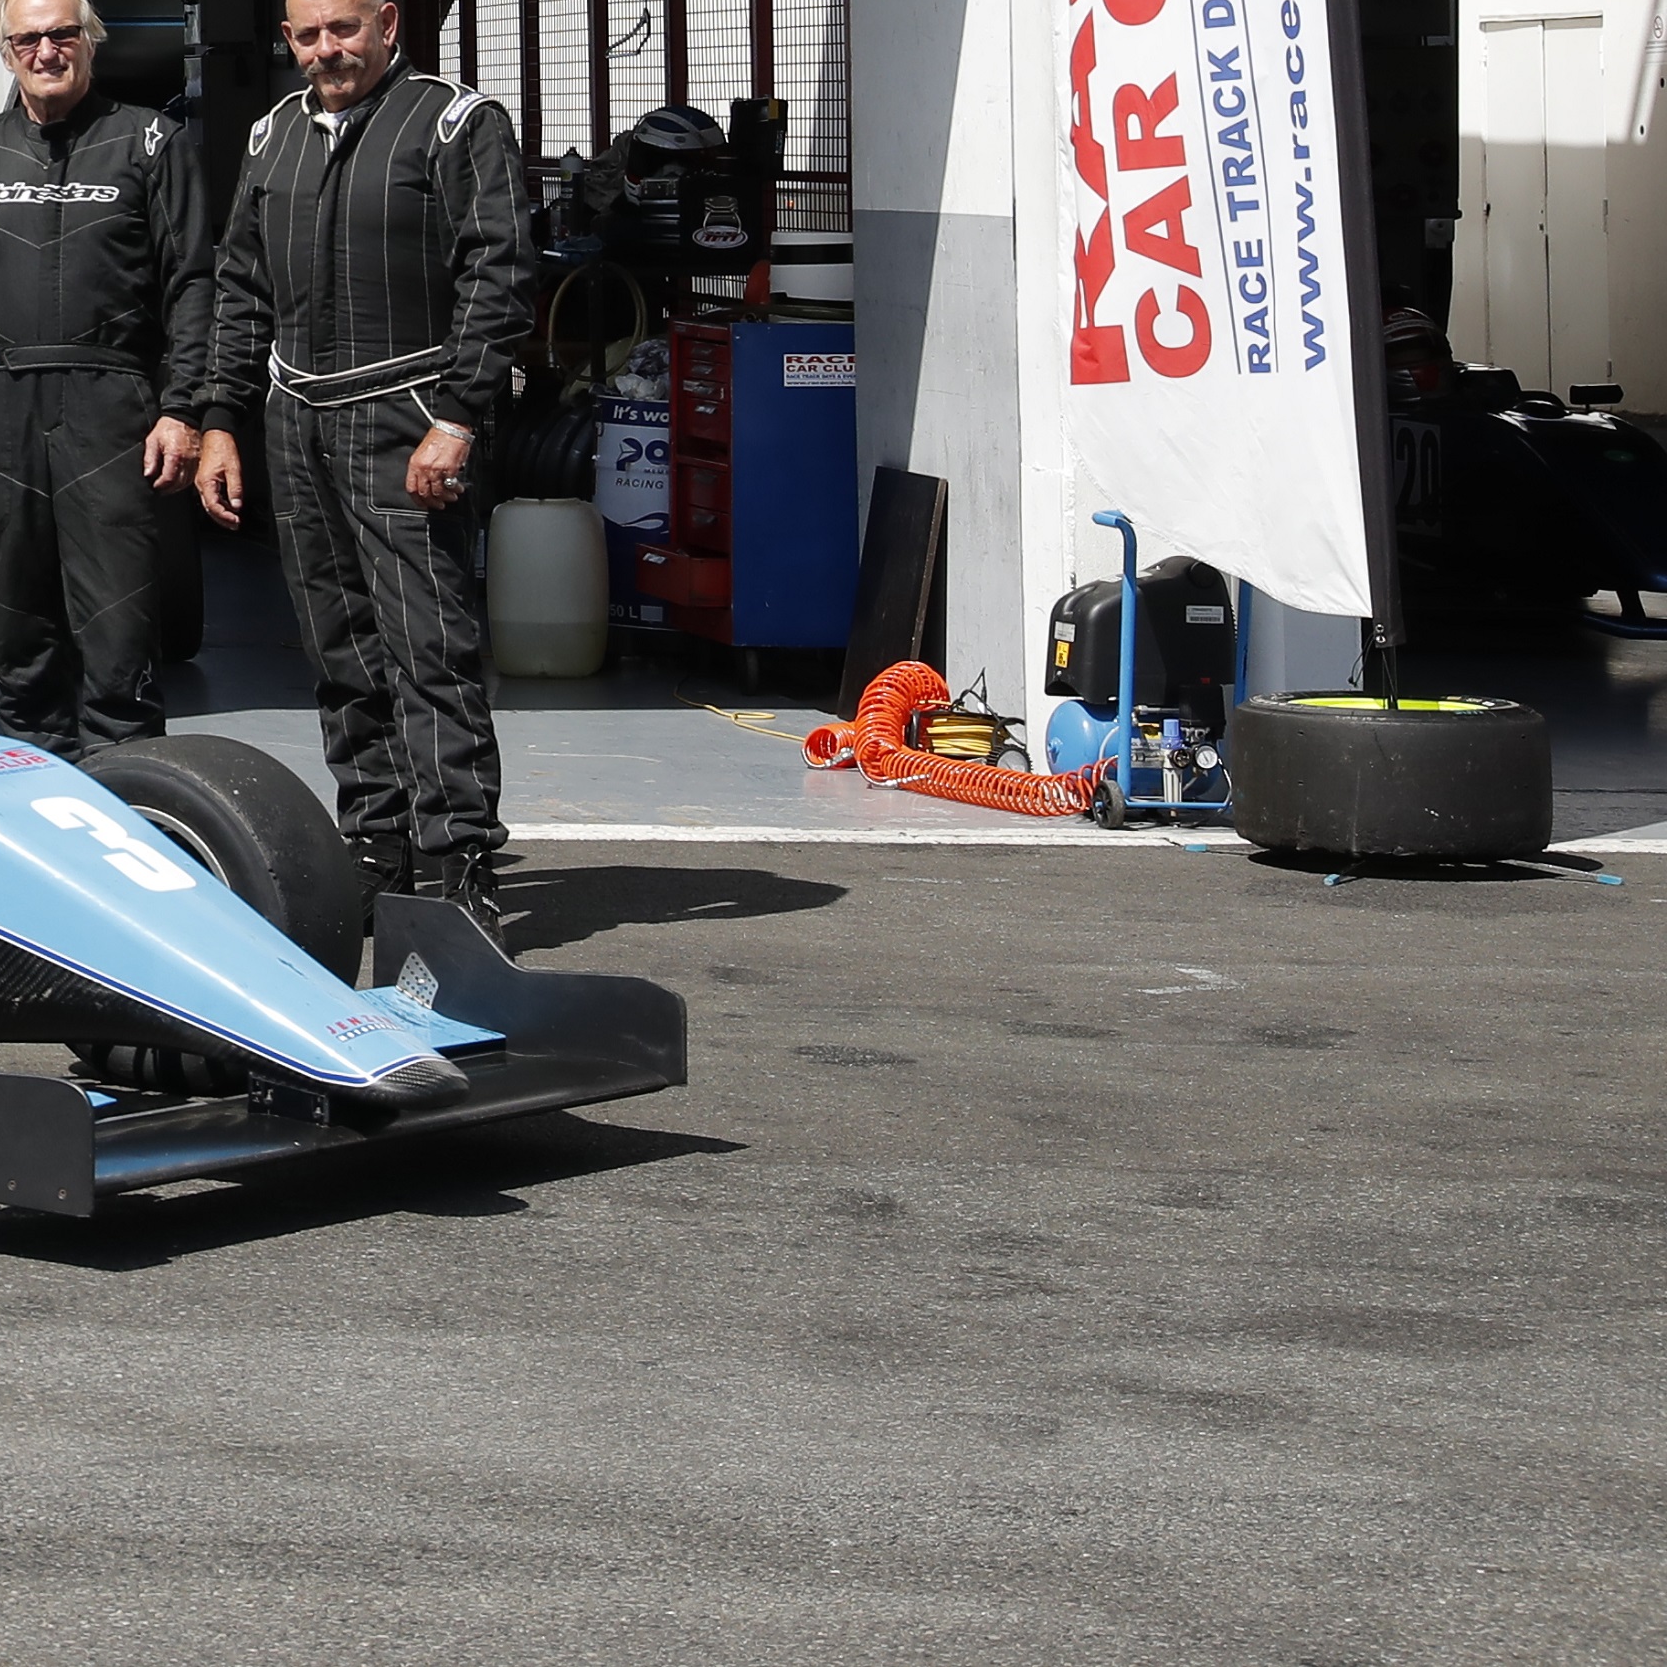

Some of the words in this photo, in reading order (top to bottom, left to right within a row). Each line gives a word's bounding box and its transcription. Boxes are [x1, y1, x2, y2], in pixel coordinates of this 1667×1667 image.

[1207, 45, 1260, 223] TRACK
[1111, 71, 1212, 378] CAR
[1232, 238, 1272, 374] RACE
[613, 405, 638, 421] It's
[786, 364, 818, 373] CAR
[822, 364, 856, 373] CLU
[615, 477, 665, 490] RACING
[29, 796, 197, 892] 3
